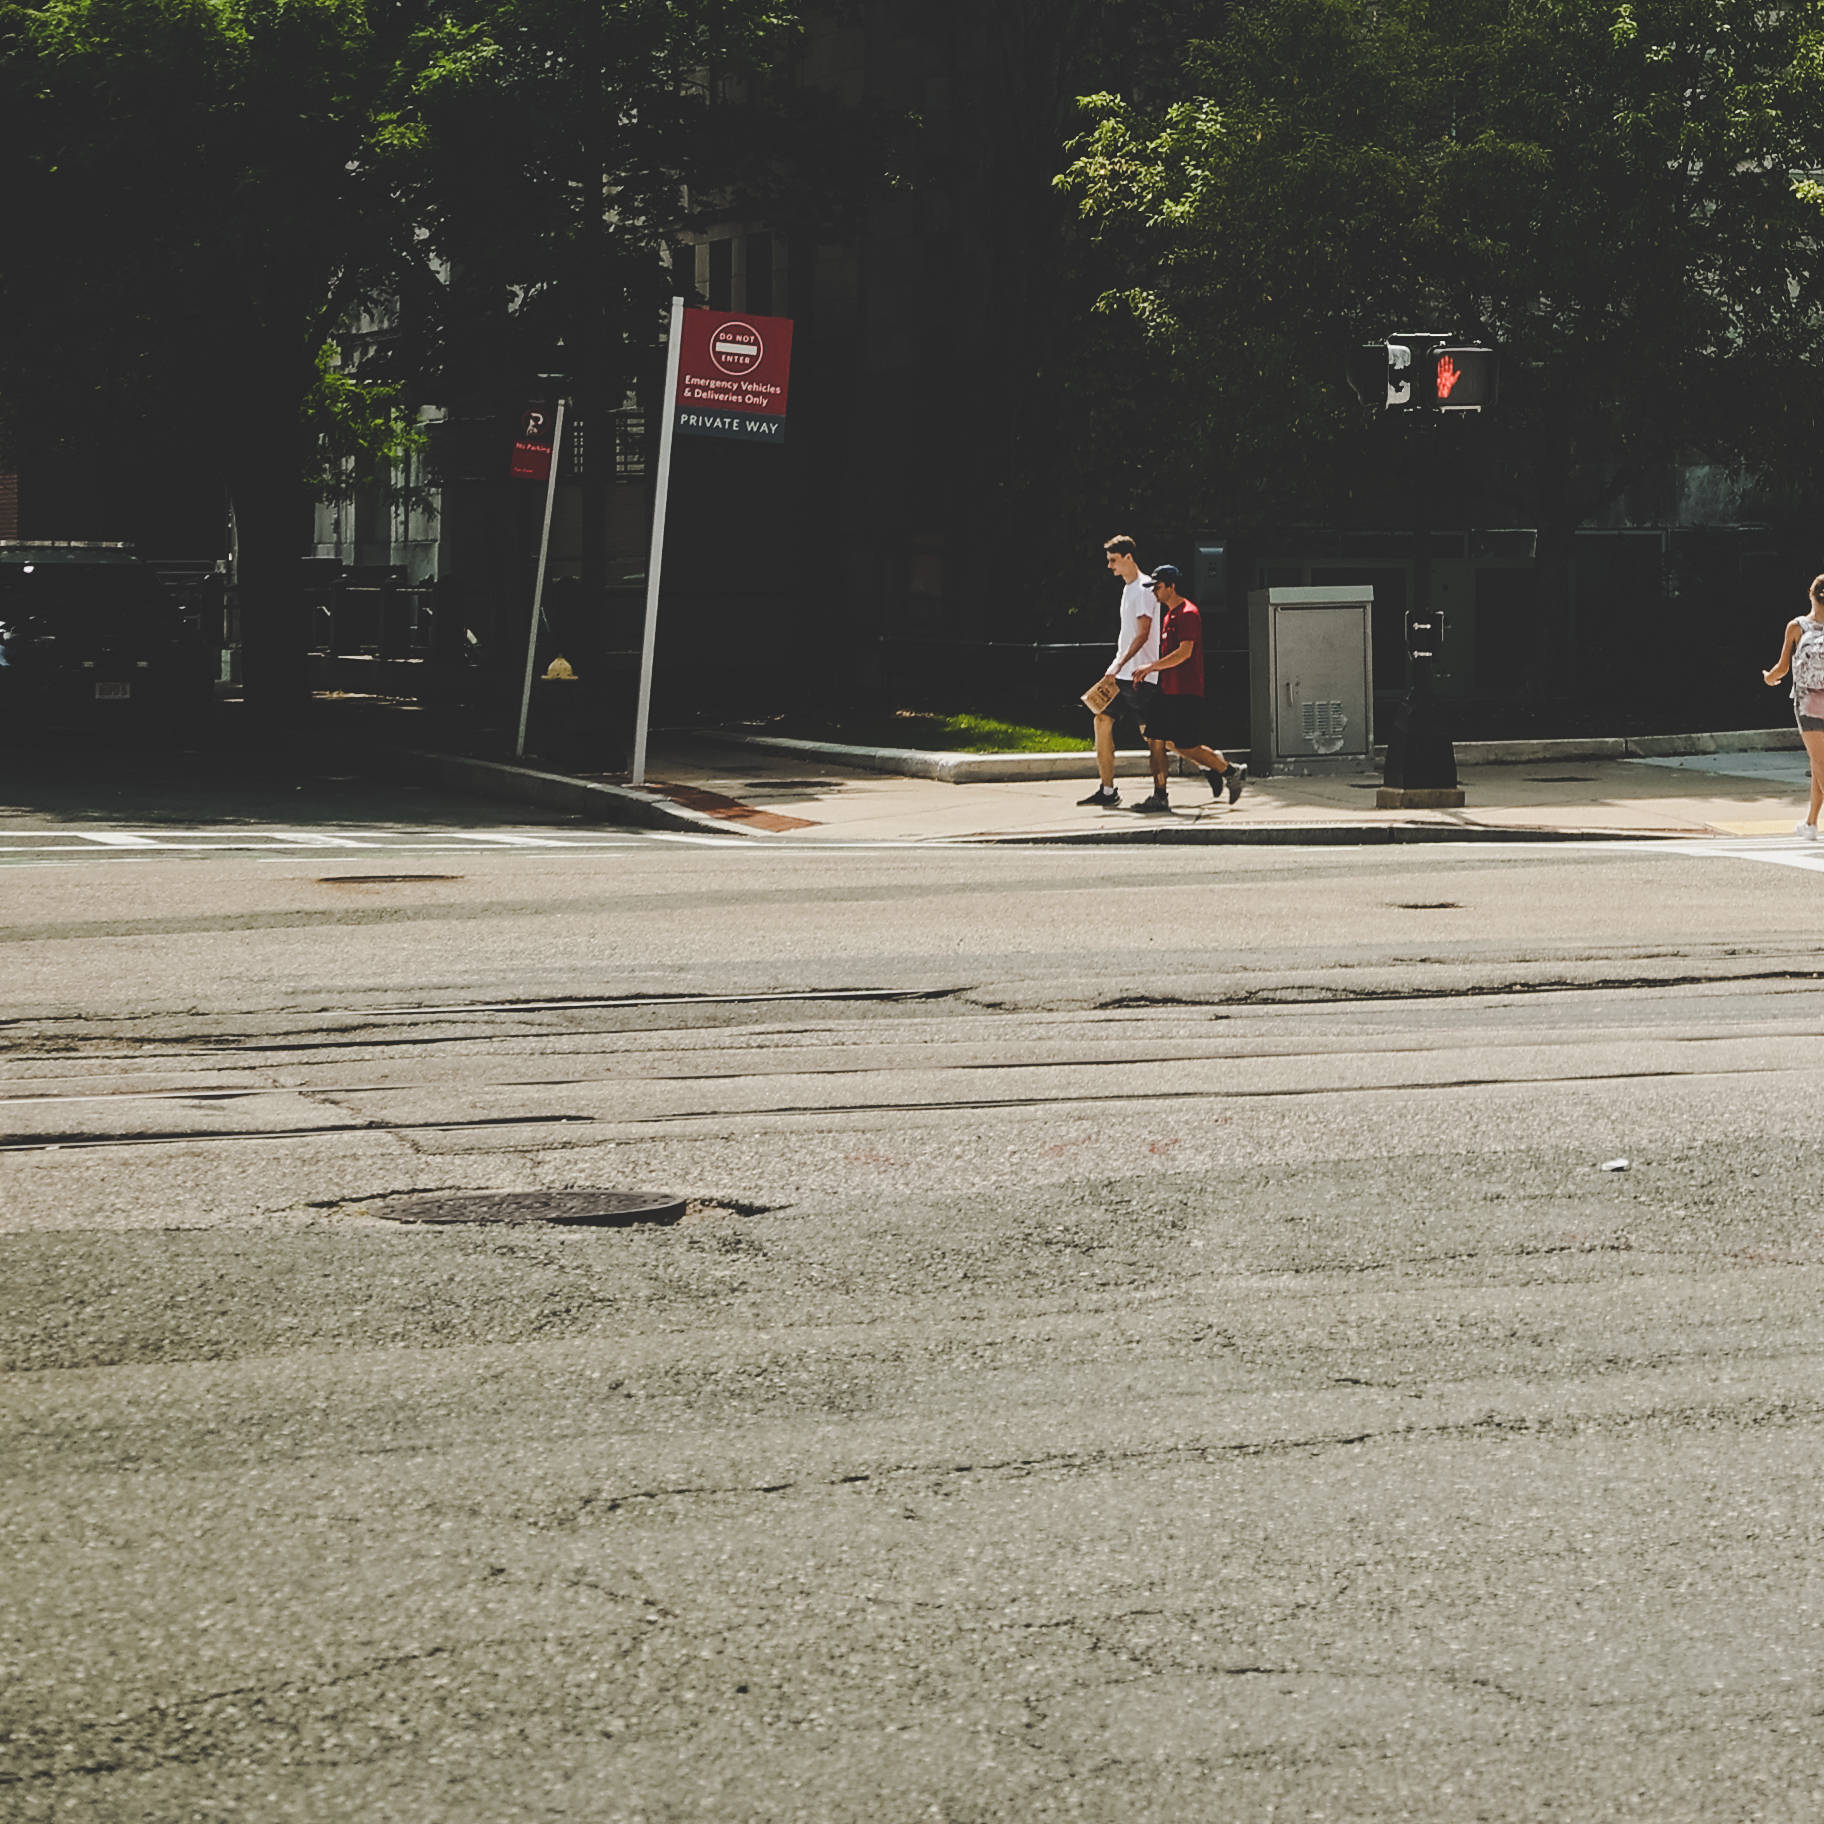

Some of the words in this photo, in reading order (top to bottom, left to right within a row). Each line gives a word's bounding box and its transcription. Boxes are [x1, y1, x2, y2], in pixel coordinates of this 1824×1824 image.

[719, 333, 732, 341] DO
[736, 334, 755, 343] NOT
[721, 354, 750, 364] ENTER
[685, 375, 738, 391] Emergency
[741, 381, 781, 394] Vehicles
[683, 387, 691, 397] &
[694, 389, 742, 403] Deliveries
[745, 394, 768, 407] Only
[680, 414, 740, 431] PRIVATE
[746, 420, 778, 434] WAY
